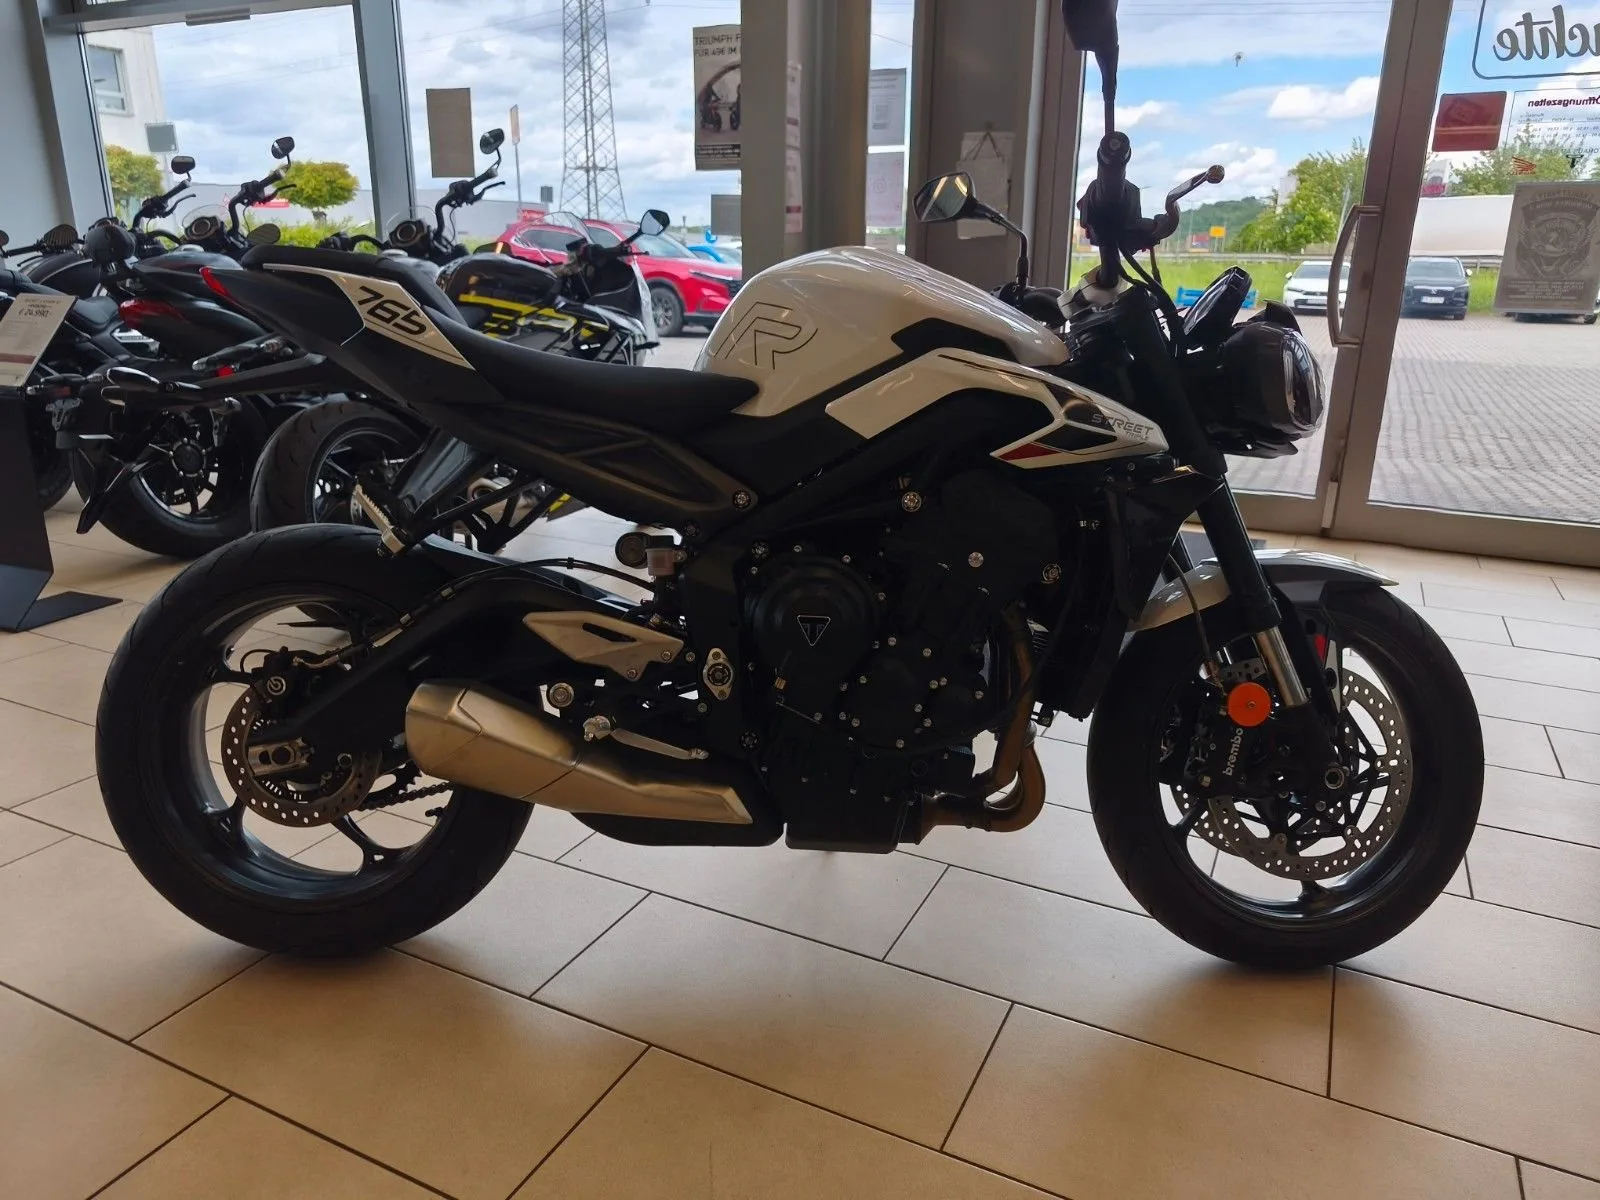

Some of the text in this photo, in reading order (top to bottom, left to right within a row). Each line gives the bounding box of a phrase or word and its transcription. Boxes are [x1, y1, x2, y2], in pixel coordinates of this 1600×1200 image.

[694, 34, 733, 46] TRIUMPH
[358, 285, 427, 335] 765
[714, 302, 818, 370] R
[1091, 413, 1154, 435] STREET
[1125, 430, 1149, 441] TRIPLE
[1222, 727, 1244, 776] brembo
